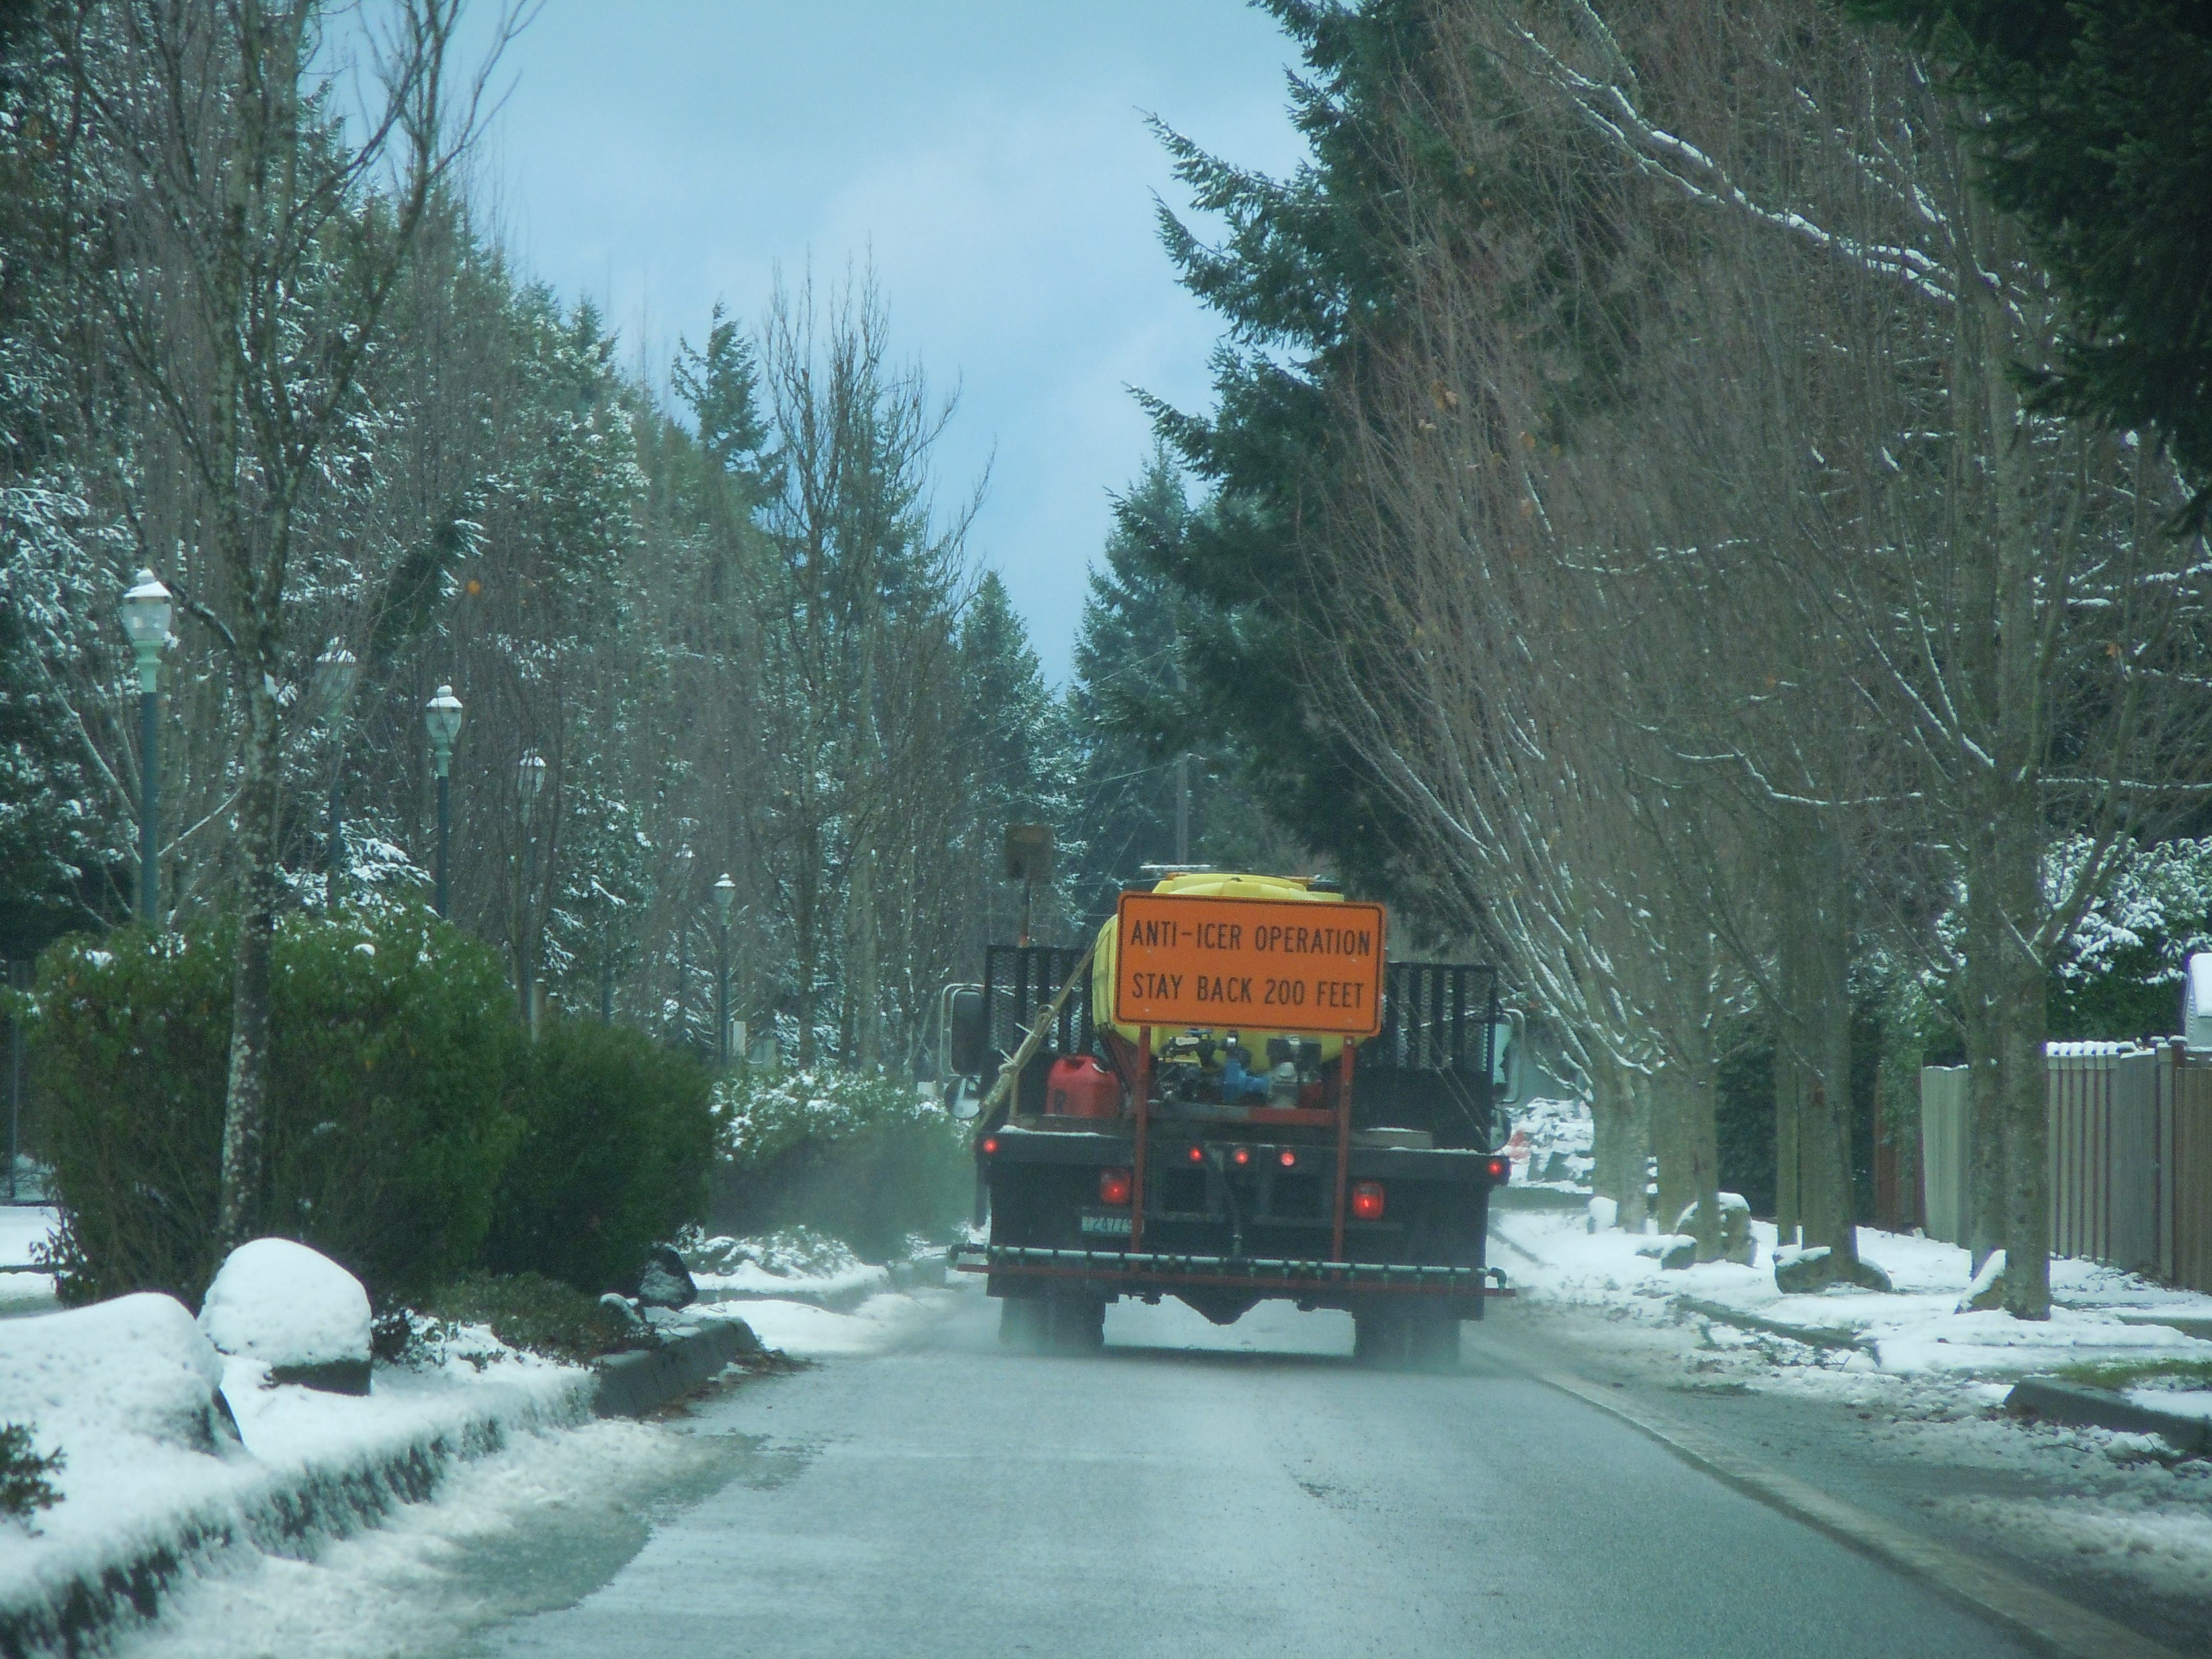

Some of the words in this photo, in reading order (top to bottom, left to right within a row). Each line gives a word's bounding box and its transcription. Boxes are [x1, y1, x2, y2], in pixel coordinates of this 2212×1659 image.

[1130, 920, 1241, 950] ANTI-ICER
[1255, 925, 1370, 956] OPERATION
[1133, 972, 1182, 999] STAY
[1197, 975, 1252, 1003] BACK
[1265, 979, 1305, 1006] 200
[1317, 982, 1364, 1009] FEET
